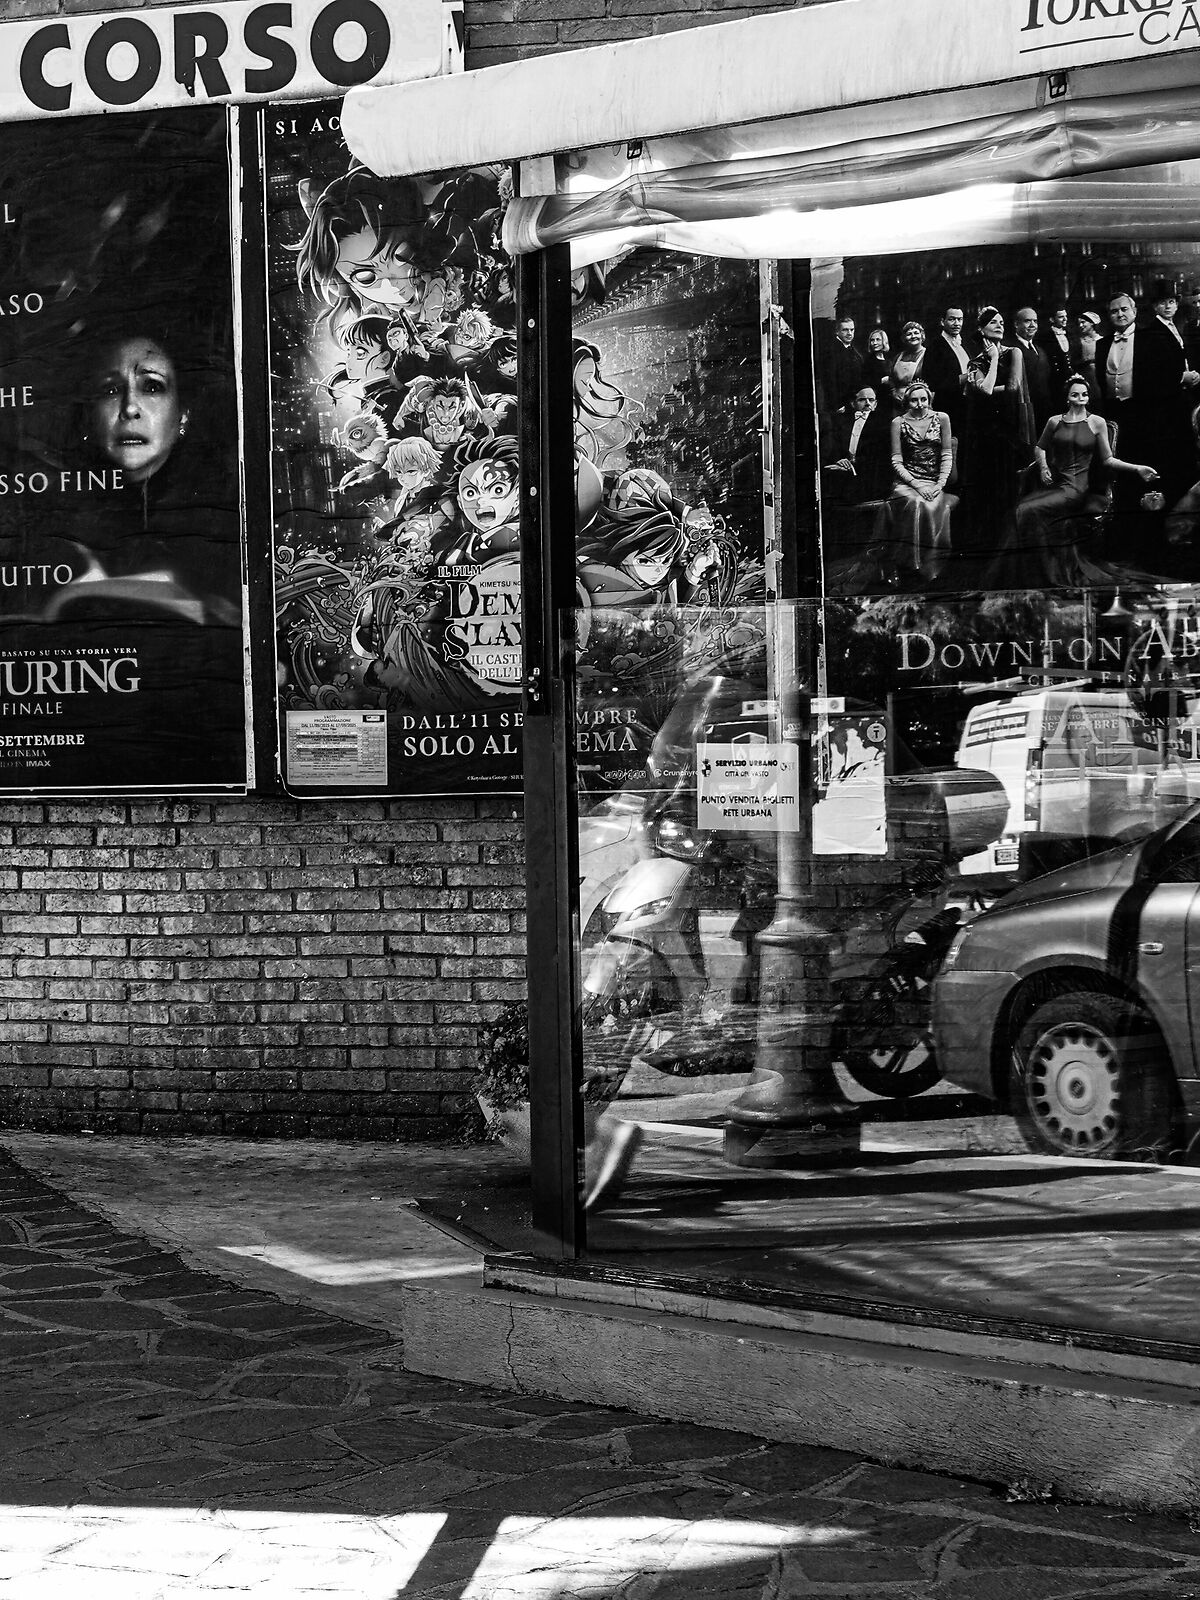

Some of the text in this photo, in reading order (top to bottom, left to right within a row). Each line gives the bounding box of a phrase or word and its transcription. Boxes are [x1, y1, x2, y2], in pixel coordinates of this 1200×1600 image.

[19, 0, 391, 112] CORSO
[275, 119, 297, 135] SI
[59, 469, 125, 493] FINE
[438, 564, 482, 578] IL FILM
[480, 581, 511, 589] KIMETSU
[54, 648, 72, 656] UNA
[76, 647, 110, 655] STORIA
[896, 632, 1123, 670] DOWNTON
[471, 655, 483, 666] IL
[1102, 671, 1180, 684] FINALE
[3, 701, 63, 716] FINALE
[402, 714, 489, 730] DALL'11
[403, 734, 475, 757] SOLO
[482, 734, 518, 755] AL
[7, 749, 47, 758] CINEMA
[749, 759, 778, 767] URBANO
[701, 796, 795, 804] PUNTO VENDITA BIGLIETTI
[723, 809, 772, 817] RETE URBANA
